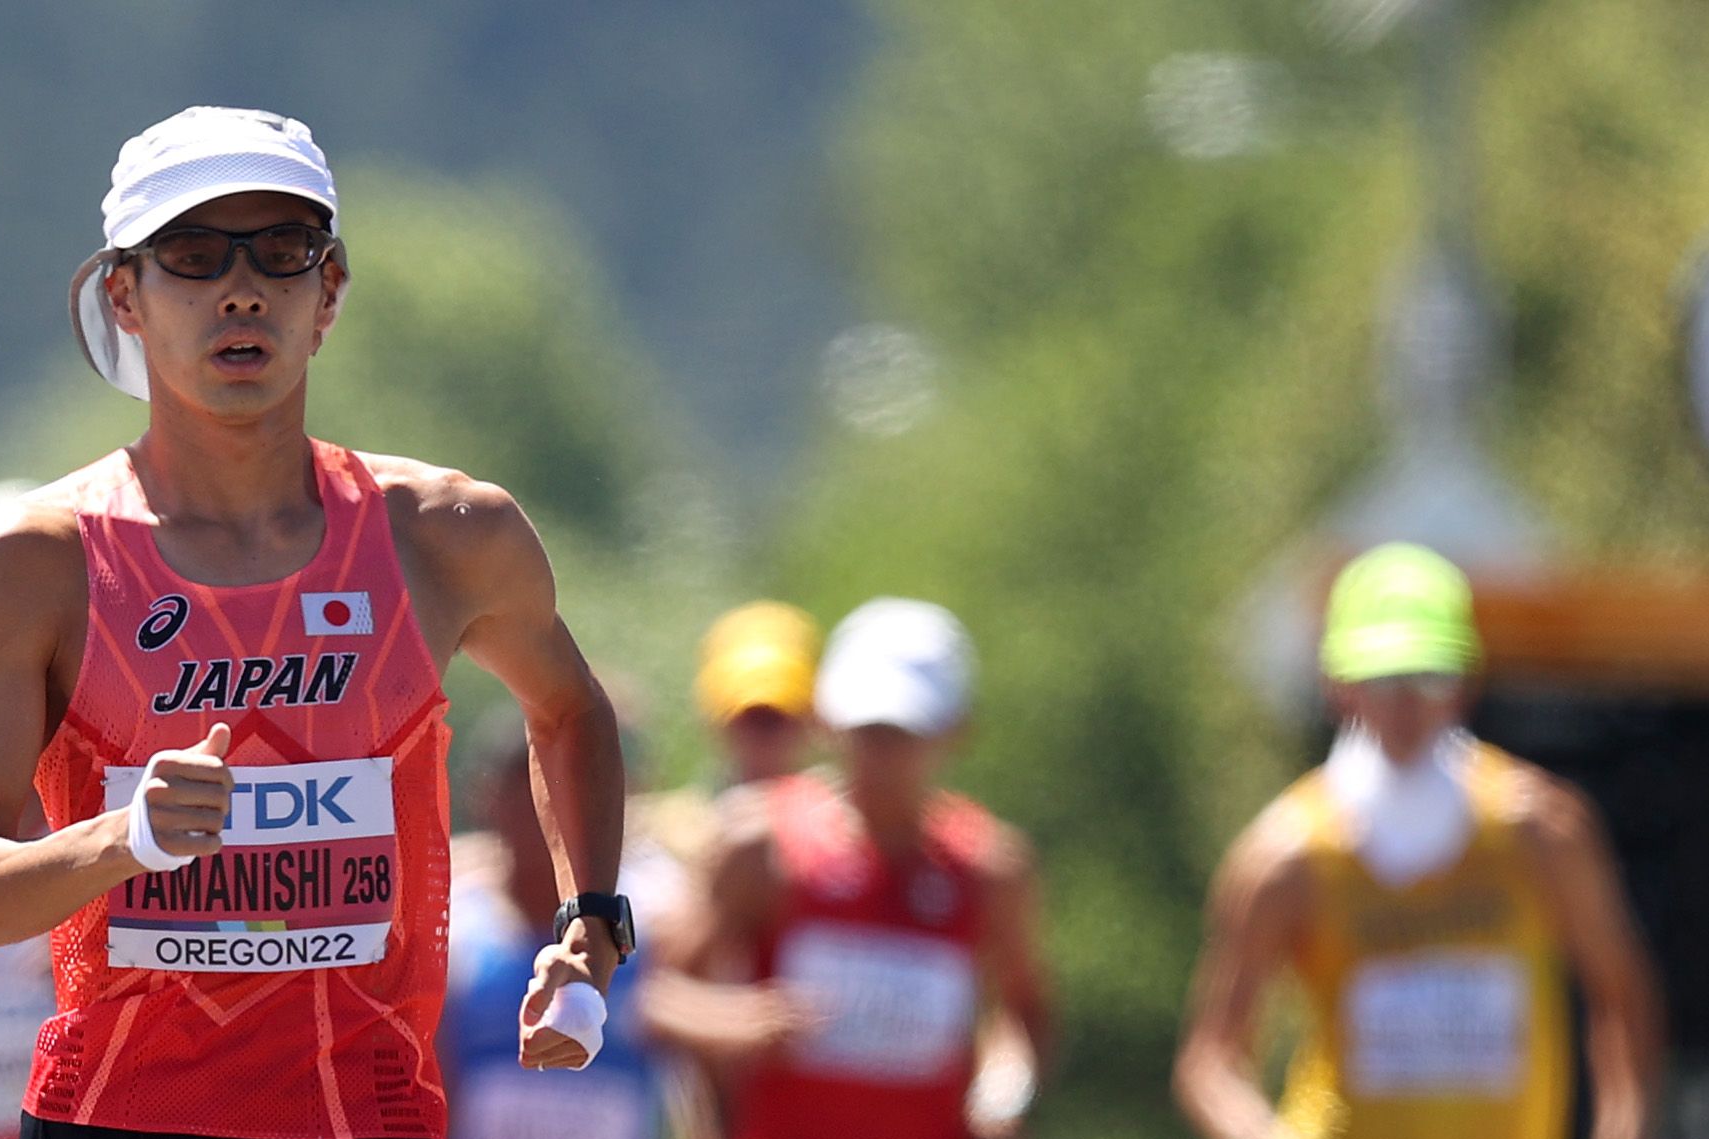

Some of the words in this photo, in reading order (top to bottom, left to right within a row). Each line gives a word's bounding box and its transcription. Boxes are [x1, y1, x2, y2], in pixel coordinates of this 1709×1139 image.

[153, 652, 359, 714] JAPAN
[343, 854, 391, 905] 258
[155, 933, 356, 966] OREGON22
